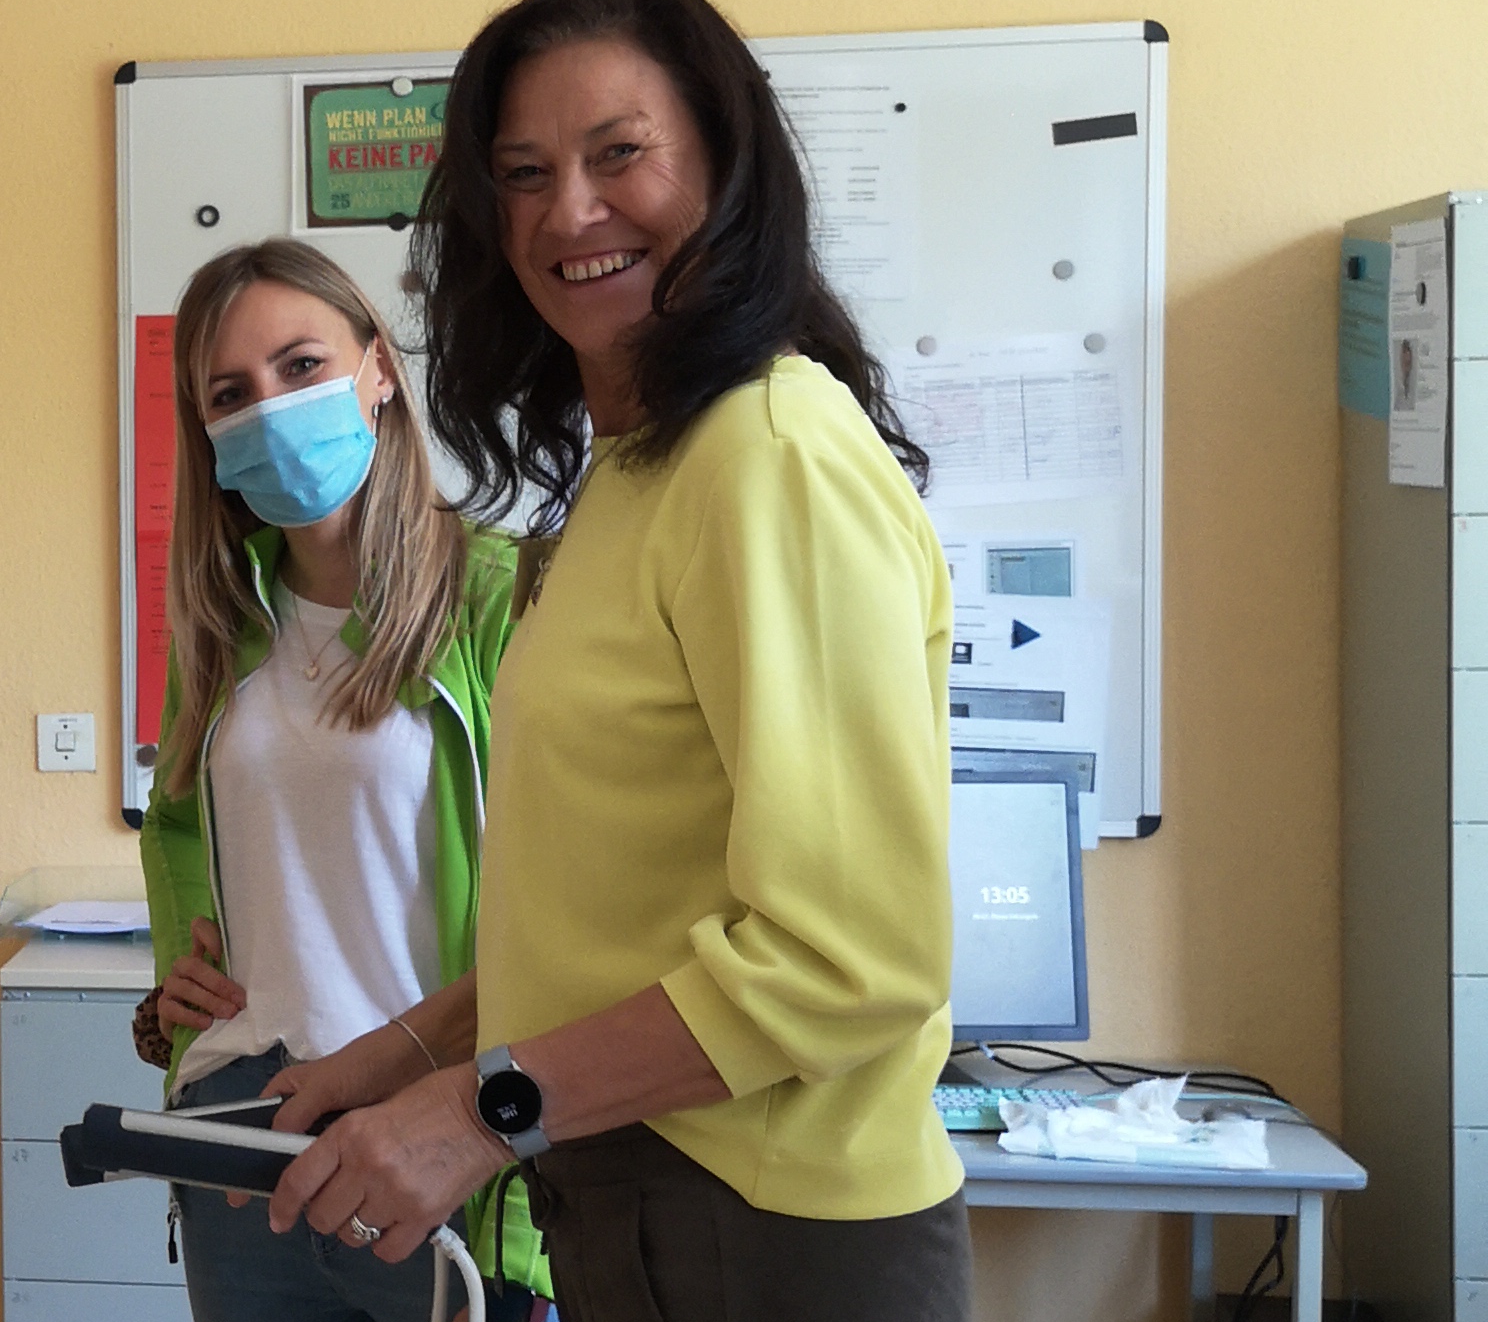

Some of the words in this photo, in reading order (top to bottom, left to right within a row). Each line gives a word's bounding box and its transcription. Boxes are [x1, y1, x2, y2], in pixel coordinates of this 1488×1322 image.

[326, 109, 377, 129] WENN
[382, 107, 426, 126] PLAN
[328, 130, 363, 142] NICHT
[328, 145, 402, 169] KEINE
[408, 142, 439, 166] PA
[330, 193, 351, 210] 25
[980, 886, 1031, 905] 13:05
